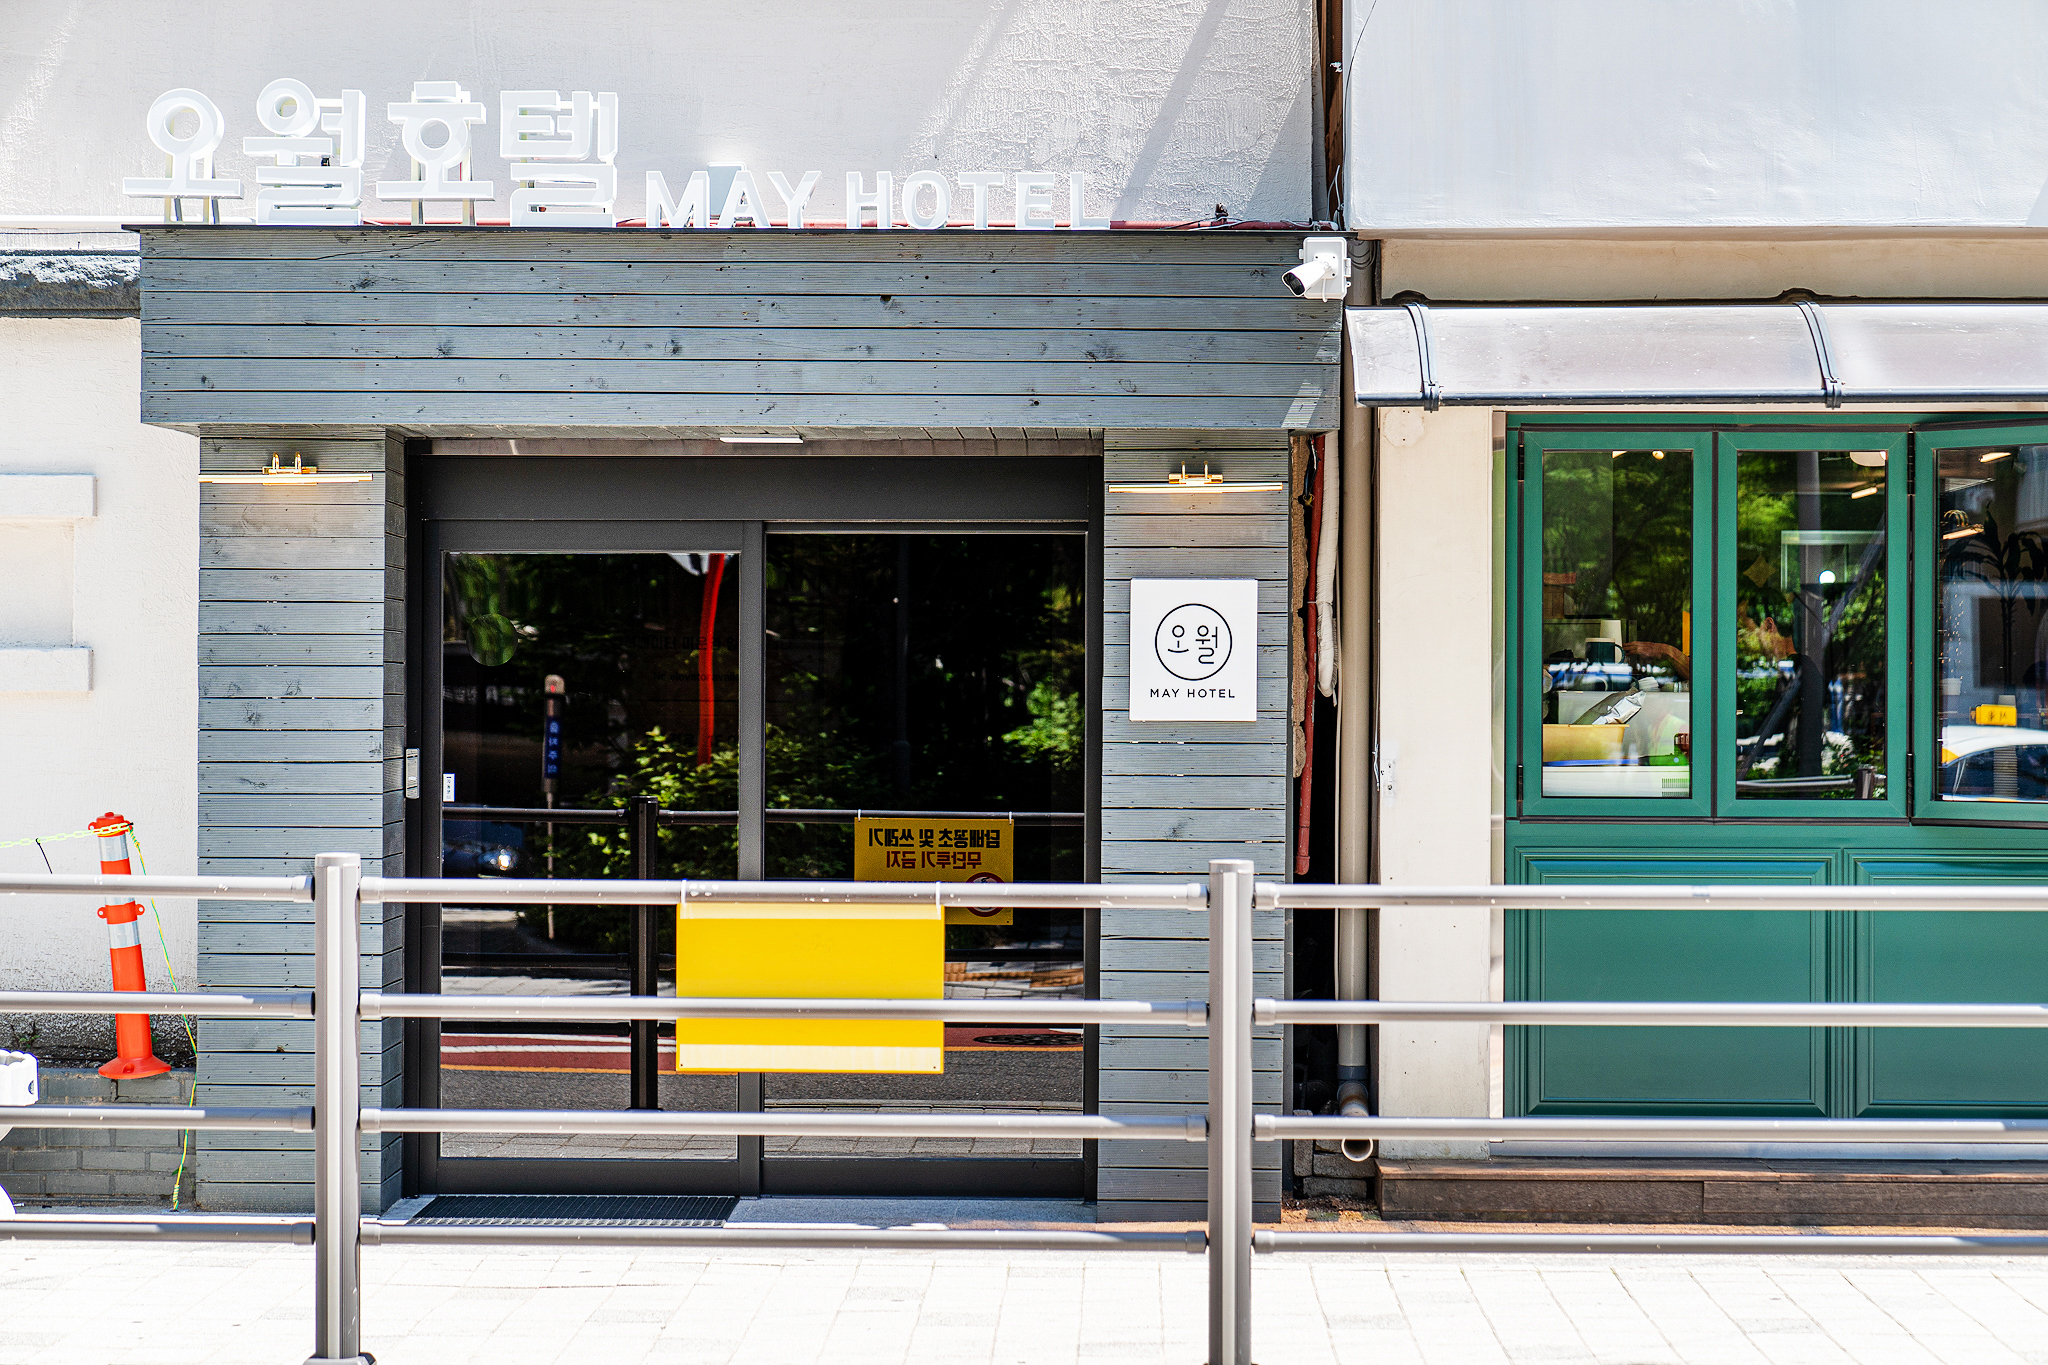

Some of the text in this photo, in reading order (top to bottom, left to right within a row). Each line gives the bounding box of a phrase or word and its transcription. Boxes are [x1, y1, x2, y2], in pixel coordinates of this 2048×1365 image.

[122, 77, 619, 227] 오월호텔
[645, 170, 1111, 230] MAY HOTEL
[1167, 624, 1218, 664] 오월
[1149, 688, 1236, 698] MAY HOTEL
